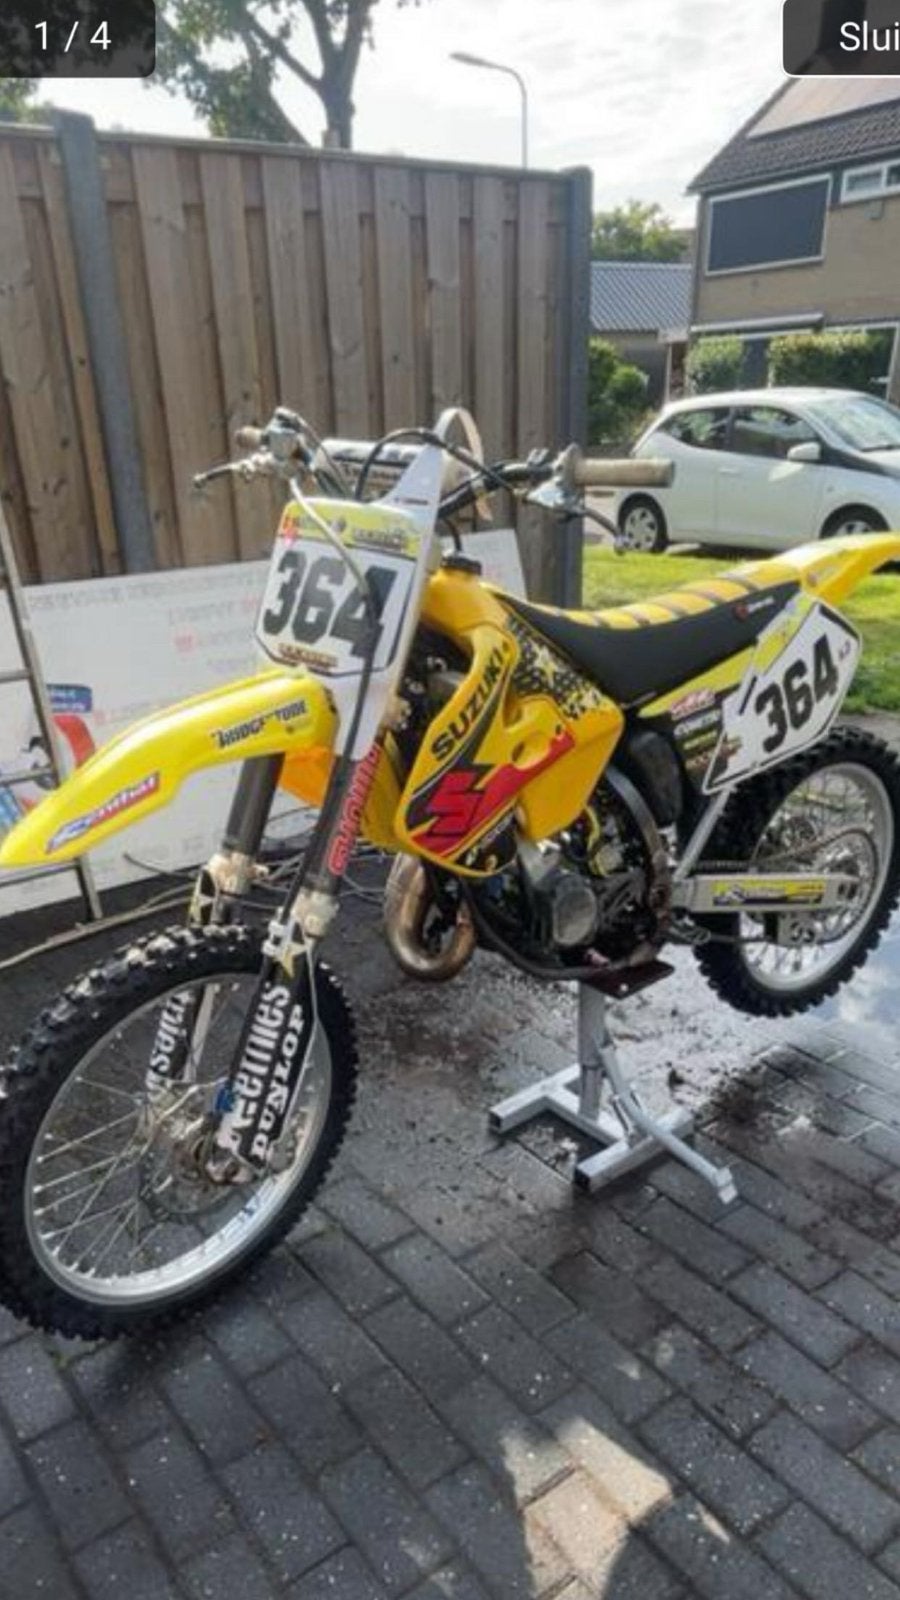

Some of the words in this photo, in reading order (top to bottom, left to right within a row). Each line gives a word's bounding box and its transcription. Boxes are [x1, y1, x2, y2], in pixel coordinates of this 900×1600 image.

[263, 550, 397, 657] 364
[431, 646, 504, 762] SUZUKI
[756, 633, 839, 753] 364
[251, 1004, 305, 1160] DUNLOP
